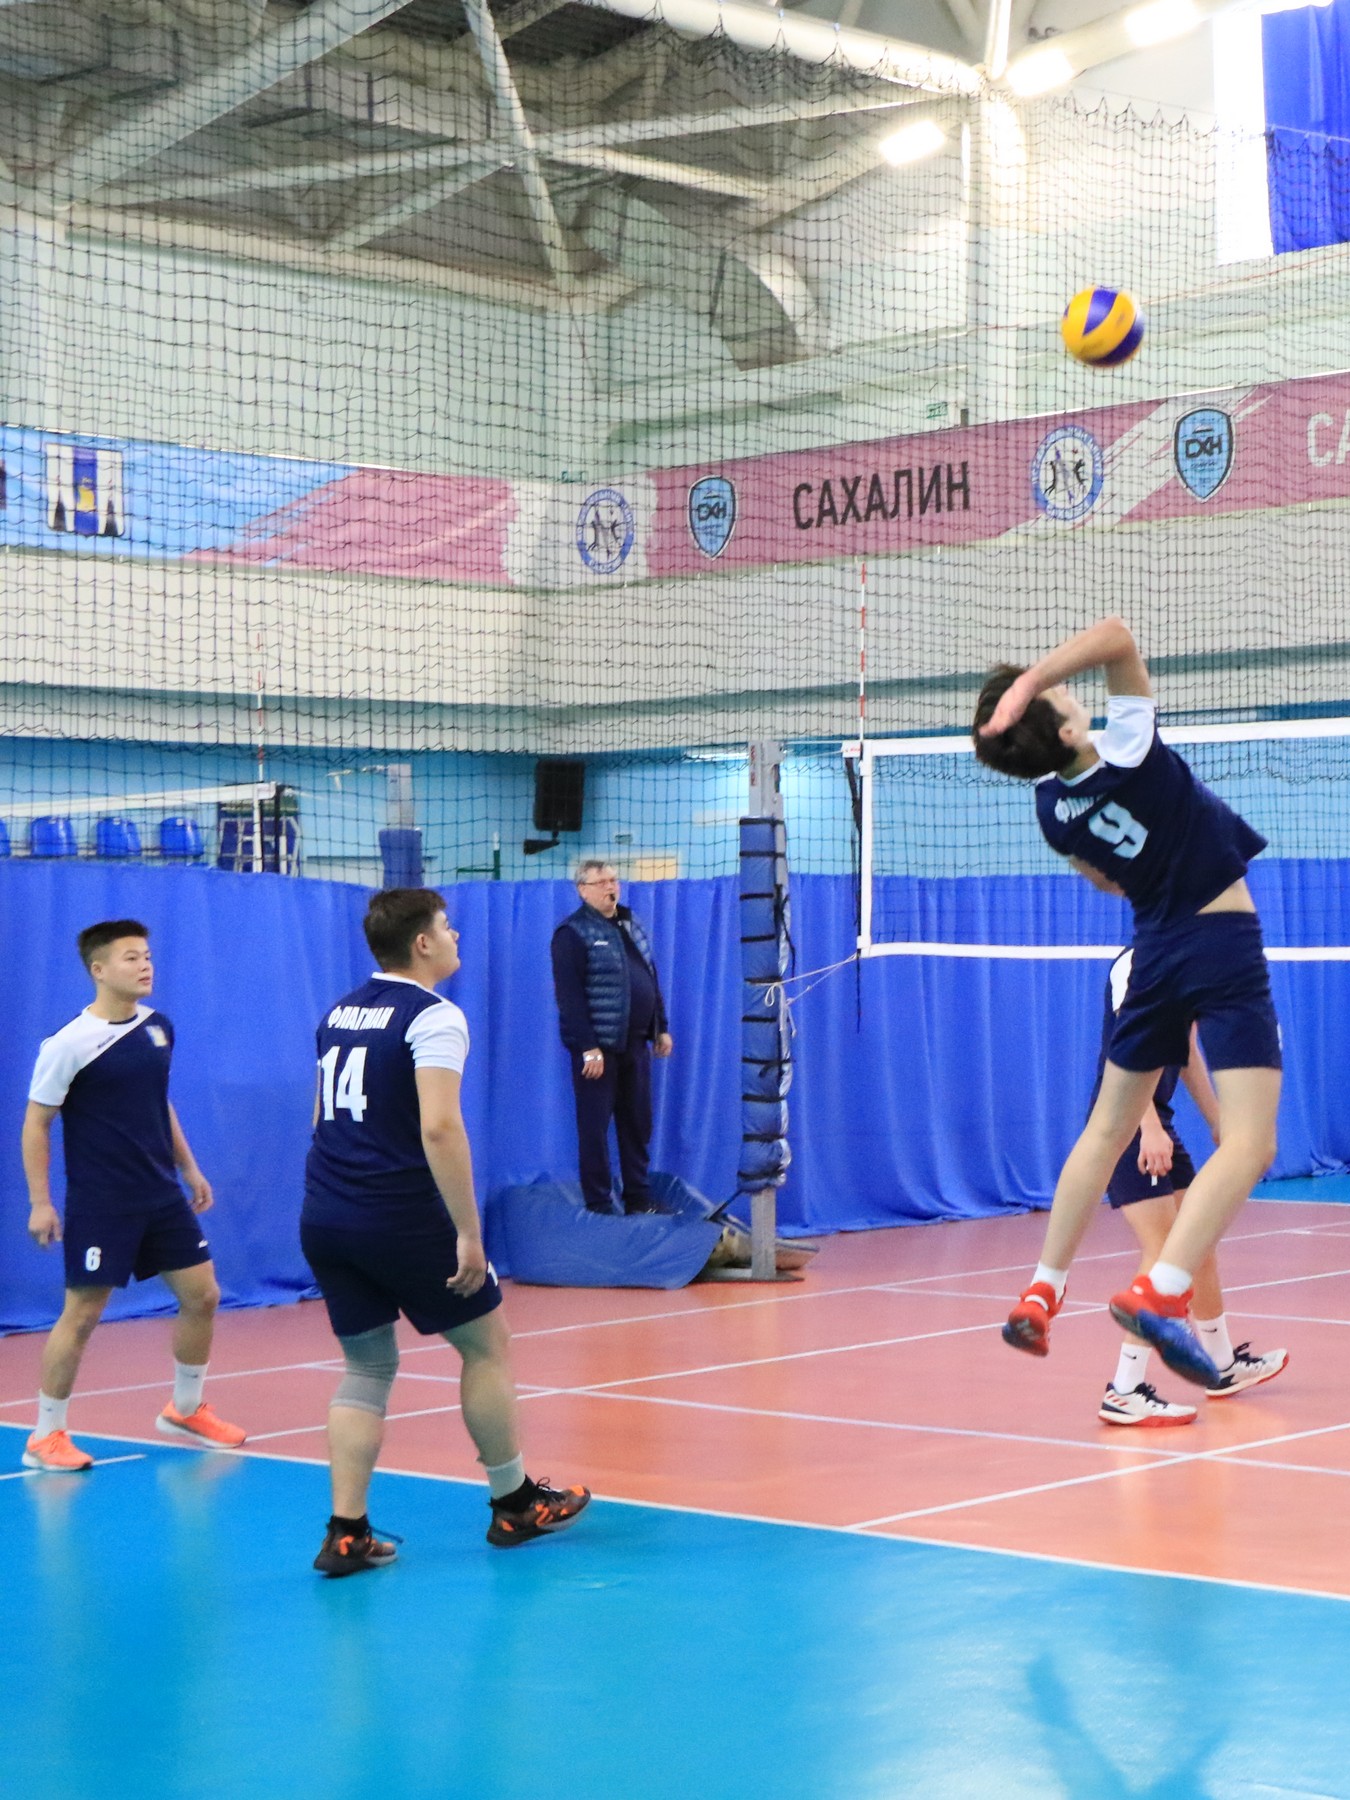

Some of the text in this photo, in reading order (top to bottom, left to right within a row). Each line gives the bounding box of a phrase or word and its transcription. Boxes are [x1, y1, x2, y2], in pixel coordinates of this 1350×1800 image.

[793, 461, 970, 530] САХАЛИН
[1088, 800, 1149, 859] 9
[327, 1005, 395, 1030] ФЛАГМАН
[321, 1045, 368, 1122] 14
[85, 1246, 101, 1272] 6
